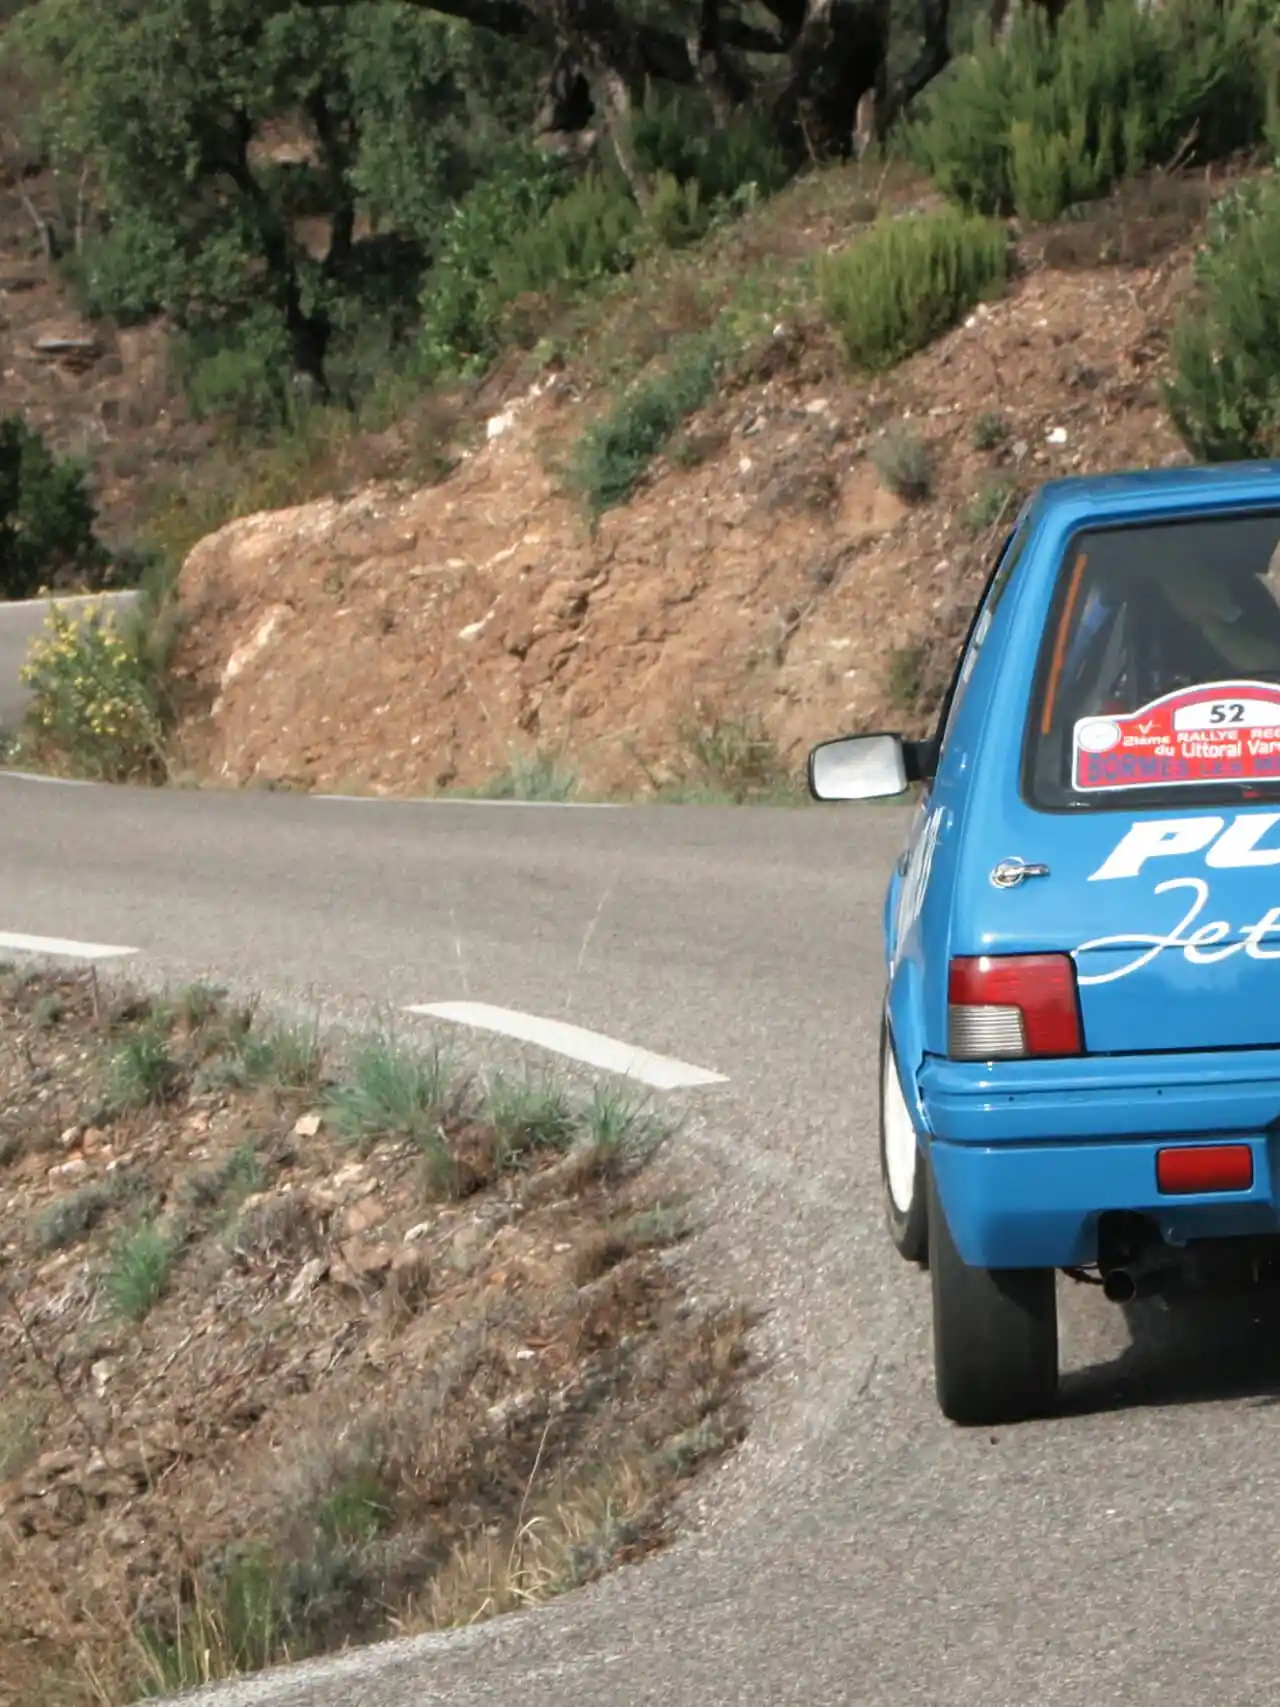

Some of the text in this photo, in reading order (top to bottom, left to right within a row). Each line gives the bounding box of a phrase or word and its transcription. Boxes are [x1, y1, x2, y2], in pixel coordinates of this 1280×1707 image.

[1209, 703, 1245, 724] 52
[1177, 730, 1238, 743] RALLYE
[1154, 744, 1175, 757] du
[1181, 740, 1242, 758] Littoral
[1086, 752, 1190, 782] BORMES
